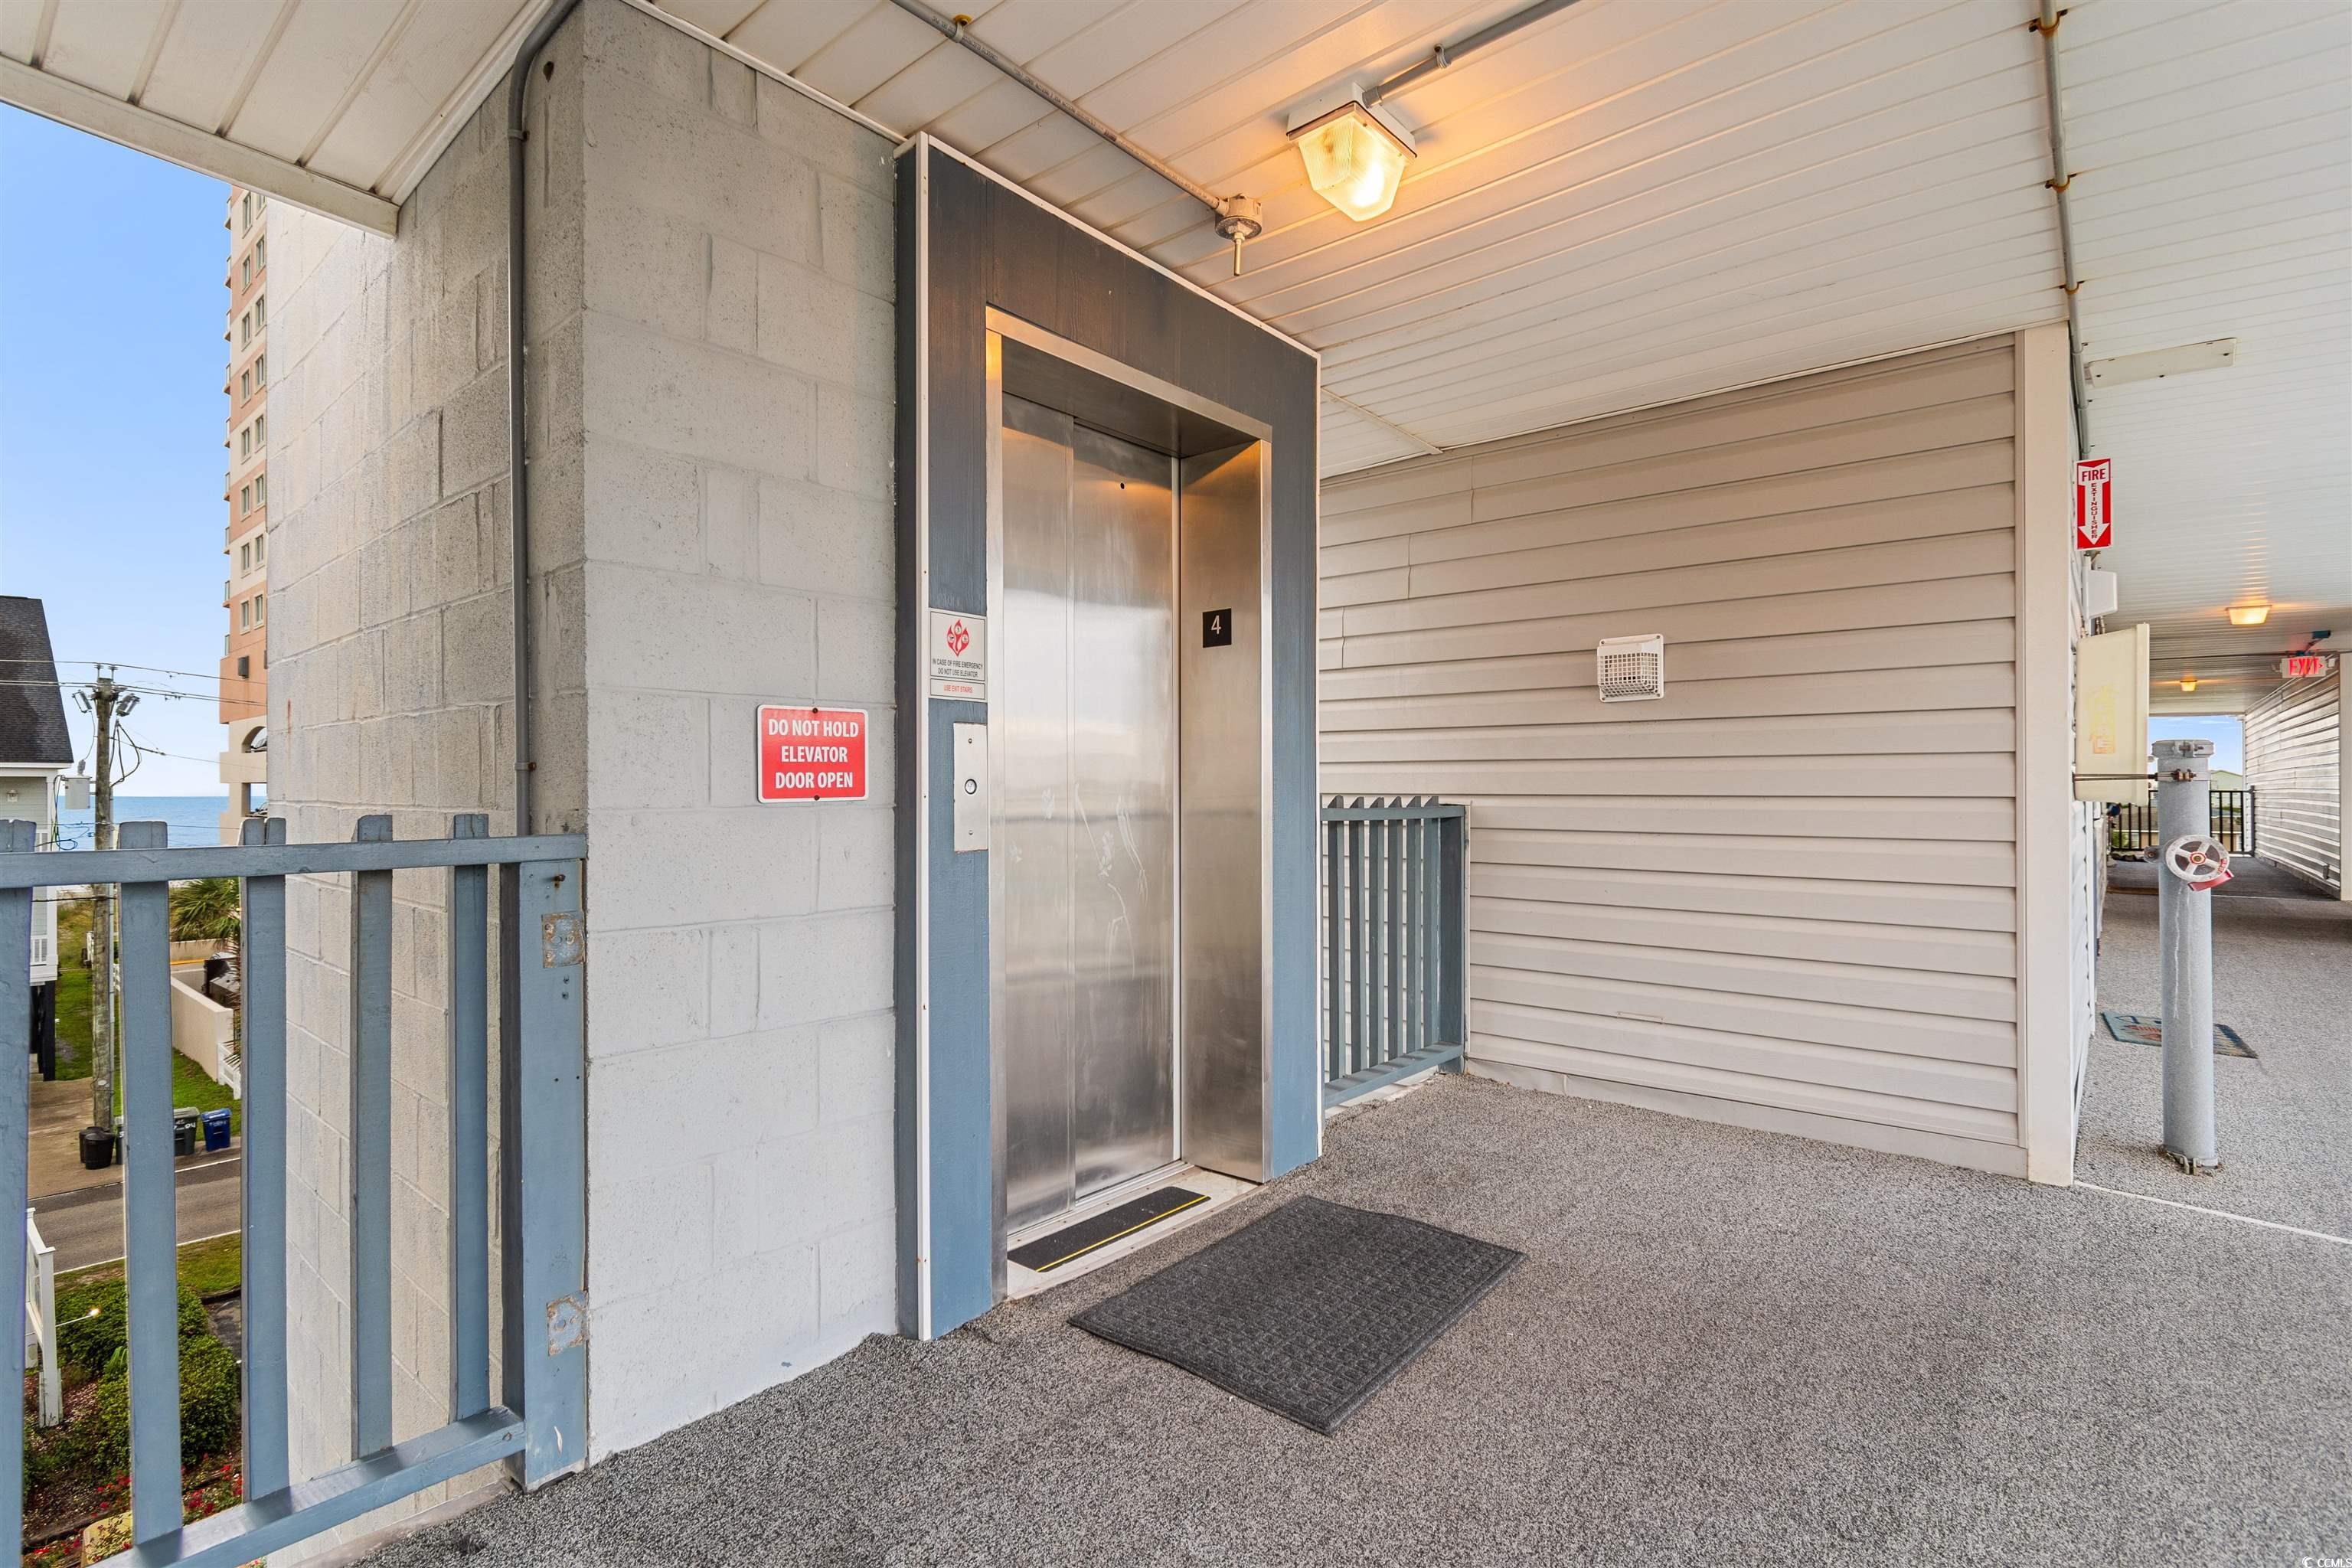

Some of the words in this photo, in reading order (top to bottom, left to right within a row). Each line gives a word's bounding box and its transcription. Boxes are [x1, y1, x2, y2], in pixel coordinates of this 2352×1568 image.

[2082, 469, 2106, 482] FIRE
[1211, 615, 1222, 635] 4
[961, 661, 983, 670] EMERGENCY
[2289, 658, 2319, 675] EXIT
[769, 718, 788, 736] DO
[792, 720, 820, 737] NOT
[823, 720, 859, 737] HOLD
[781, 746, 848, 763] ELEVATOR
[776, 772, 815, 789] DOOR
[818, 772, 853, 788] OPEN
